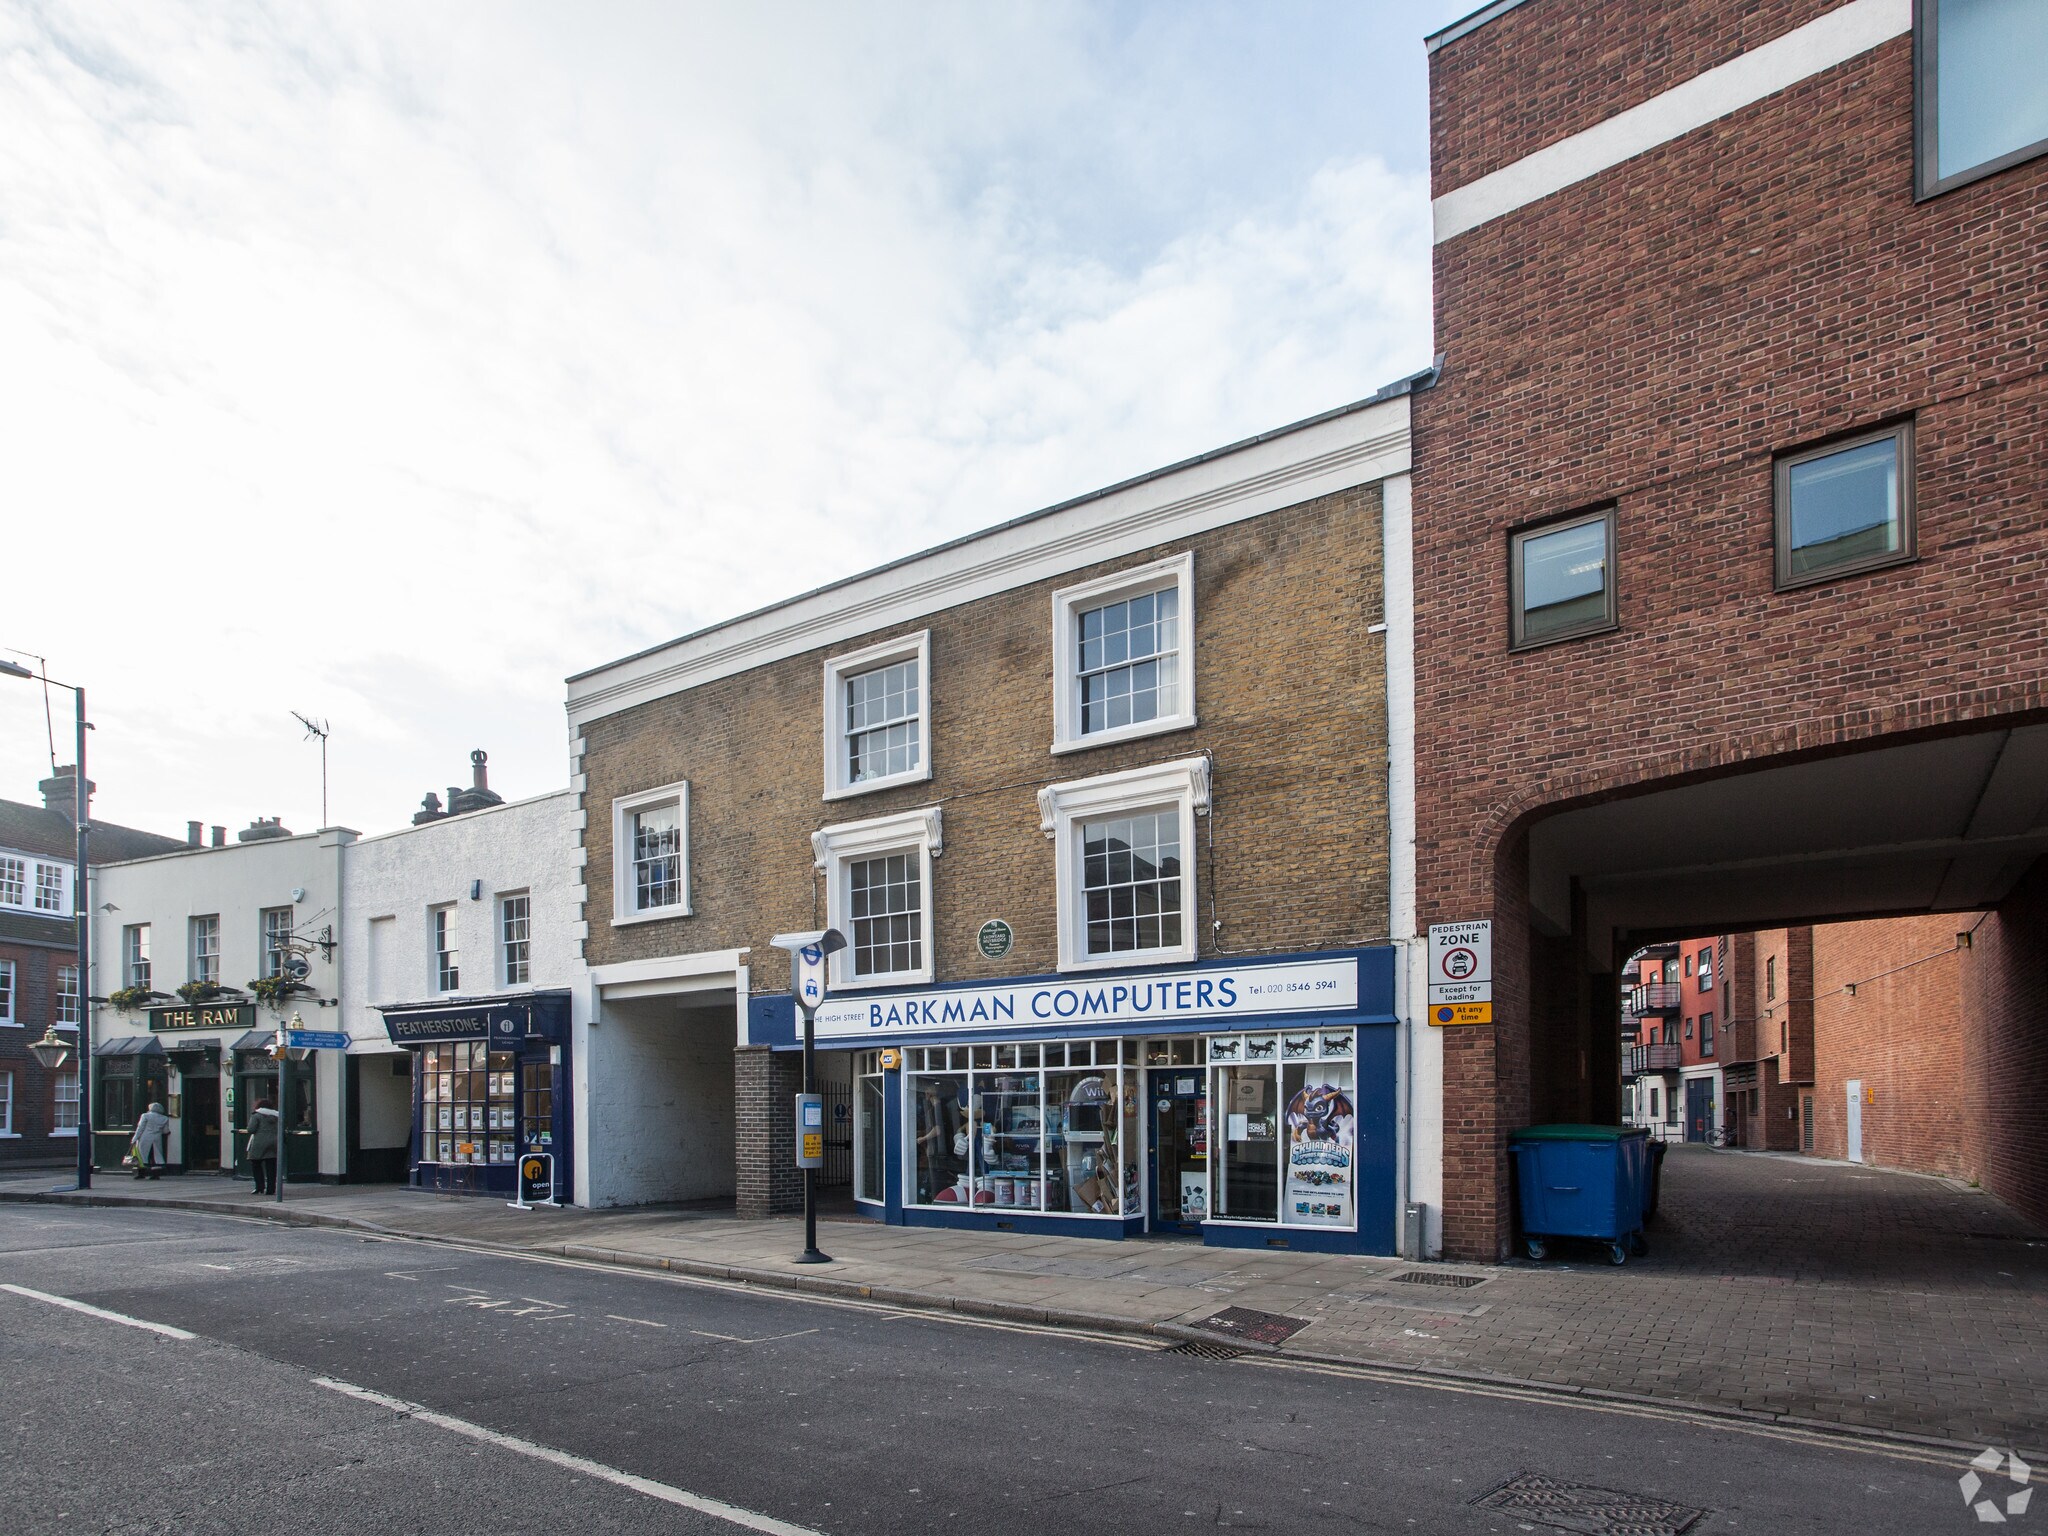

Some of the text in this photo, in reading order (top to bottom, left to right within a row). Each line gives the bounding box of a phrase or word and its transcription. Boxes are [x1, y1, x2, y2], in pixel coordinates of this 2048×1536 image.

[1432, 922, 1488, 933] PEDESTRIAN
[1440, 933, 1479, 946] ZONE
[1249, 981, 1336, 995] Tel. 020 8546 5941
[1439, 986, 1466, 994] Except
[870, 978, 1237, 1028] BARKMAN COMPUTERS
[163, 1008, 238, 1027] THE RAM
[844, 1013, 864, 1021] STREET
[395, 1018, 481, 1035] FEATHERSTONE
[1085, 1088, 1104, 1096] Wii
[1292, 1142, 1350, 1166] SKYLANDERS
